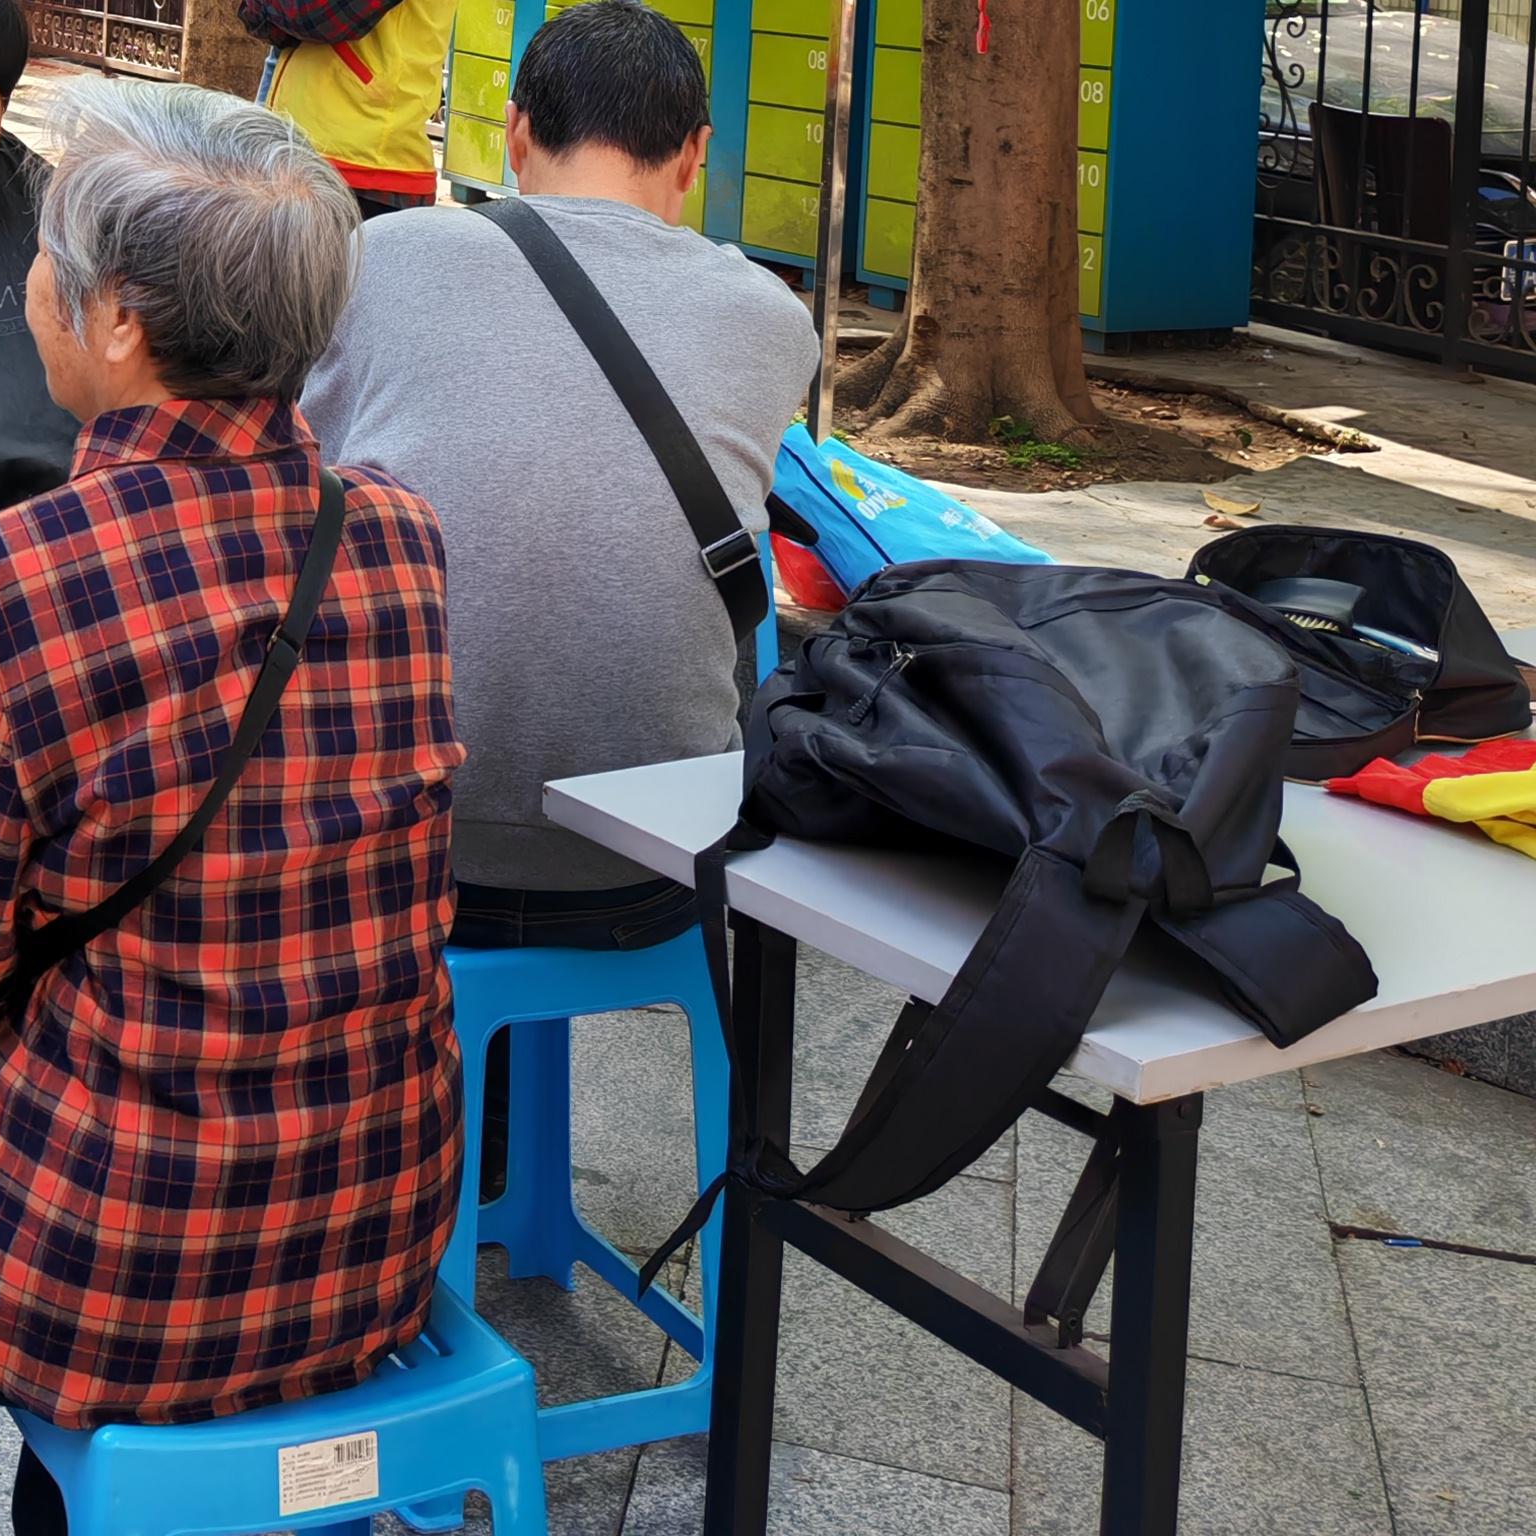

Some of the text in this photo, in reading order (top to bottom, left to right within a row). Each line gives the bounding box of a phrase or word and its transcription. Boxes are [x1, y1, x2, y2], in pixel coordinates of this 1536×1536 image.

[496, 8, 511, 26] 07
[808, 49, 826, 70] 08
[492, 70, 507, 88] 09
[1080, 80, 1104, 104] 08
[805, 123, 822, 144] 10
[1077, 164, 1099, 187] 10
